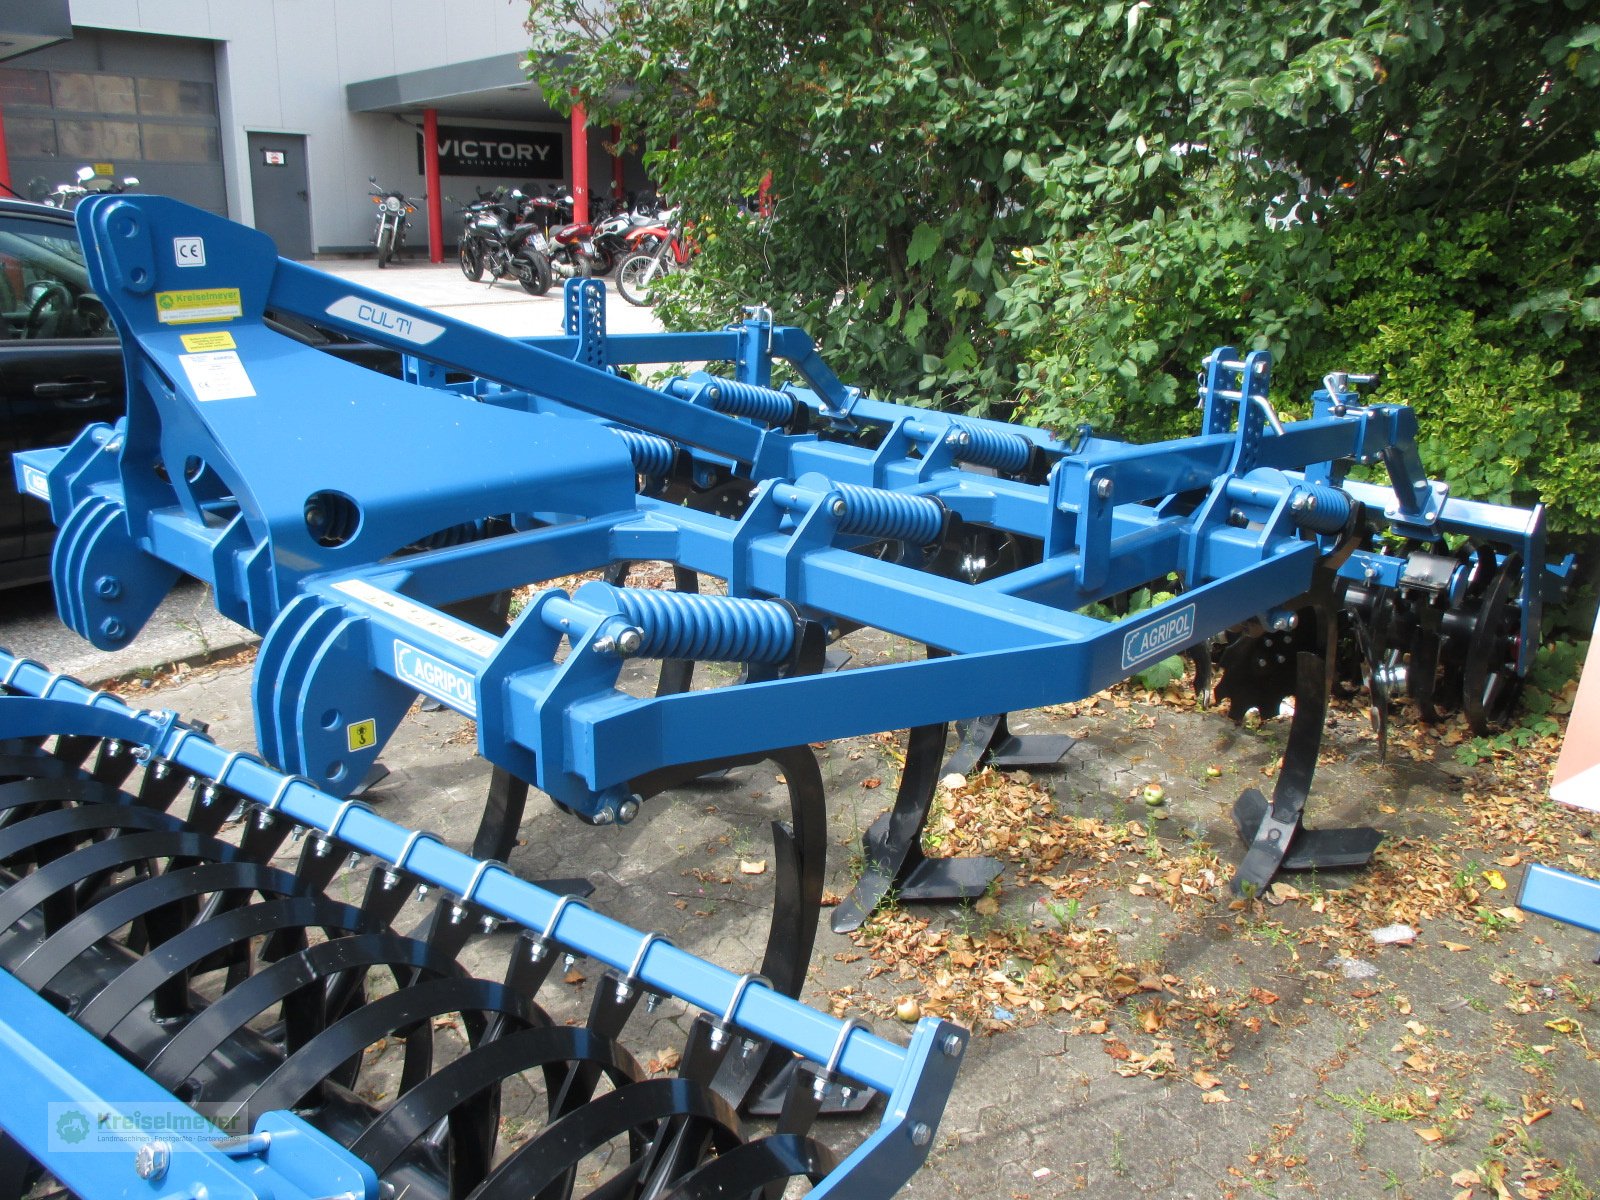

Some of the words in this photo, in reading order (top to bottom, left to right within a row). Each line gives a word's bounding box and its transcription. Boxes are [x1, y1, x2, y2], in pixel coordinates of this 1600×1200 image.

[437, 139, 550, 161] VICTORY
[179, 244, 199, 258] CE
[175, 291, 238, 303] Kreiselmeyer
[358, 304, 413, 335] CULTI
[1140, 613, 1190, 653] AGRIPOL
